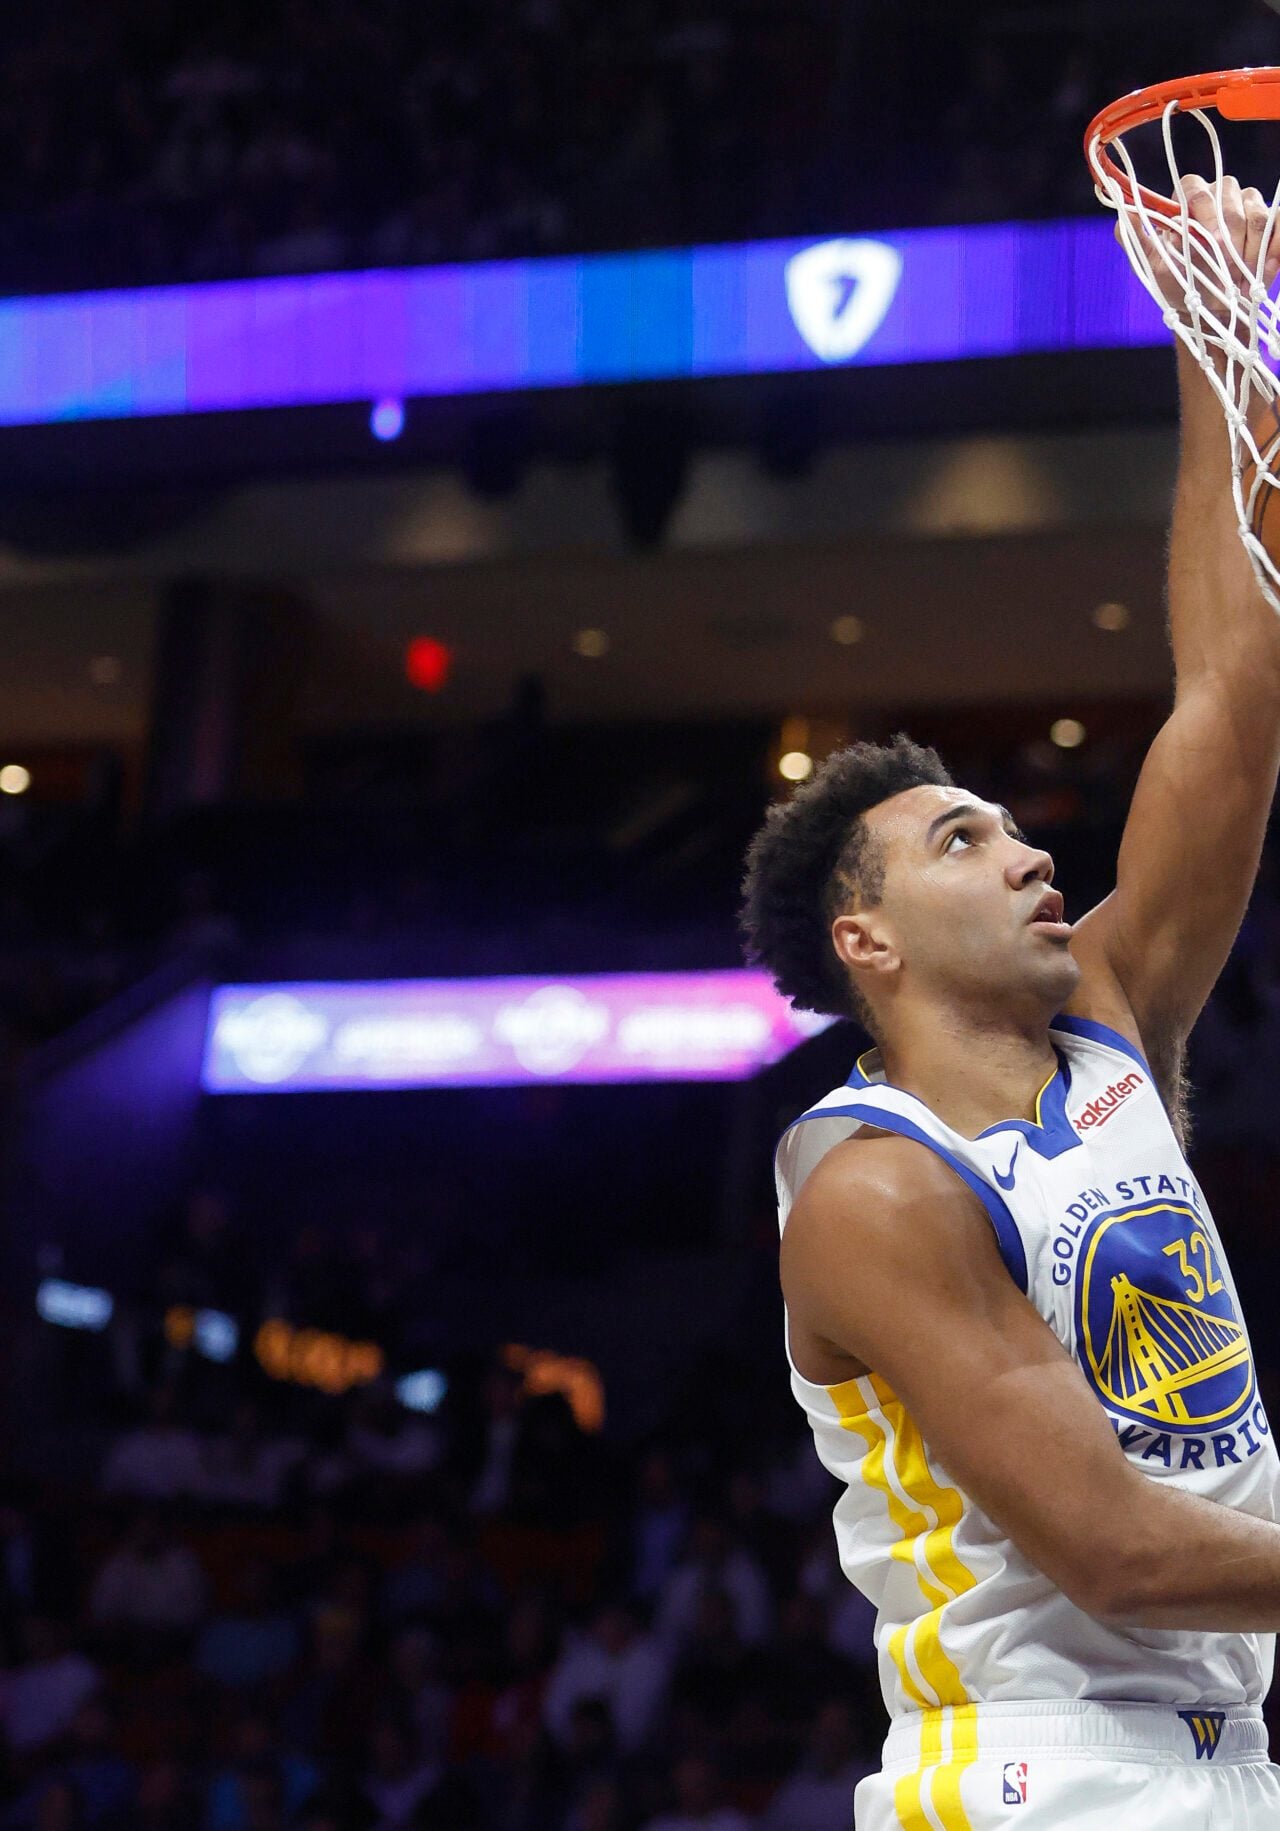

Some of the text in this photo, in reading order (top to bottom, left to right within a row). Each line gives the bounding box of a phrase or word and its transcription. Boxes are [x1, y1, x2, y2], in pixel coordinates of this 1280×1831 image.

[1052, 1187, 1111, 1286] GOLDEN
[1162, 1231, 1223, 1303] 32
[1005, 1791, 1019, 1802] NBA
